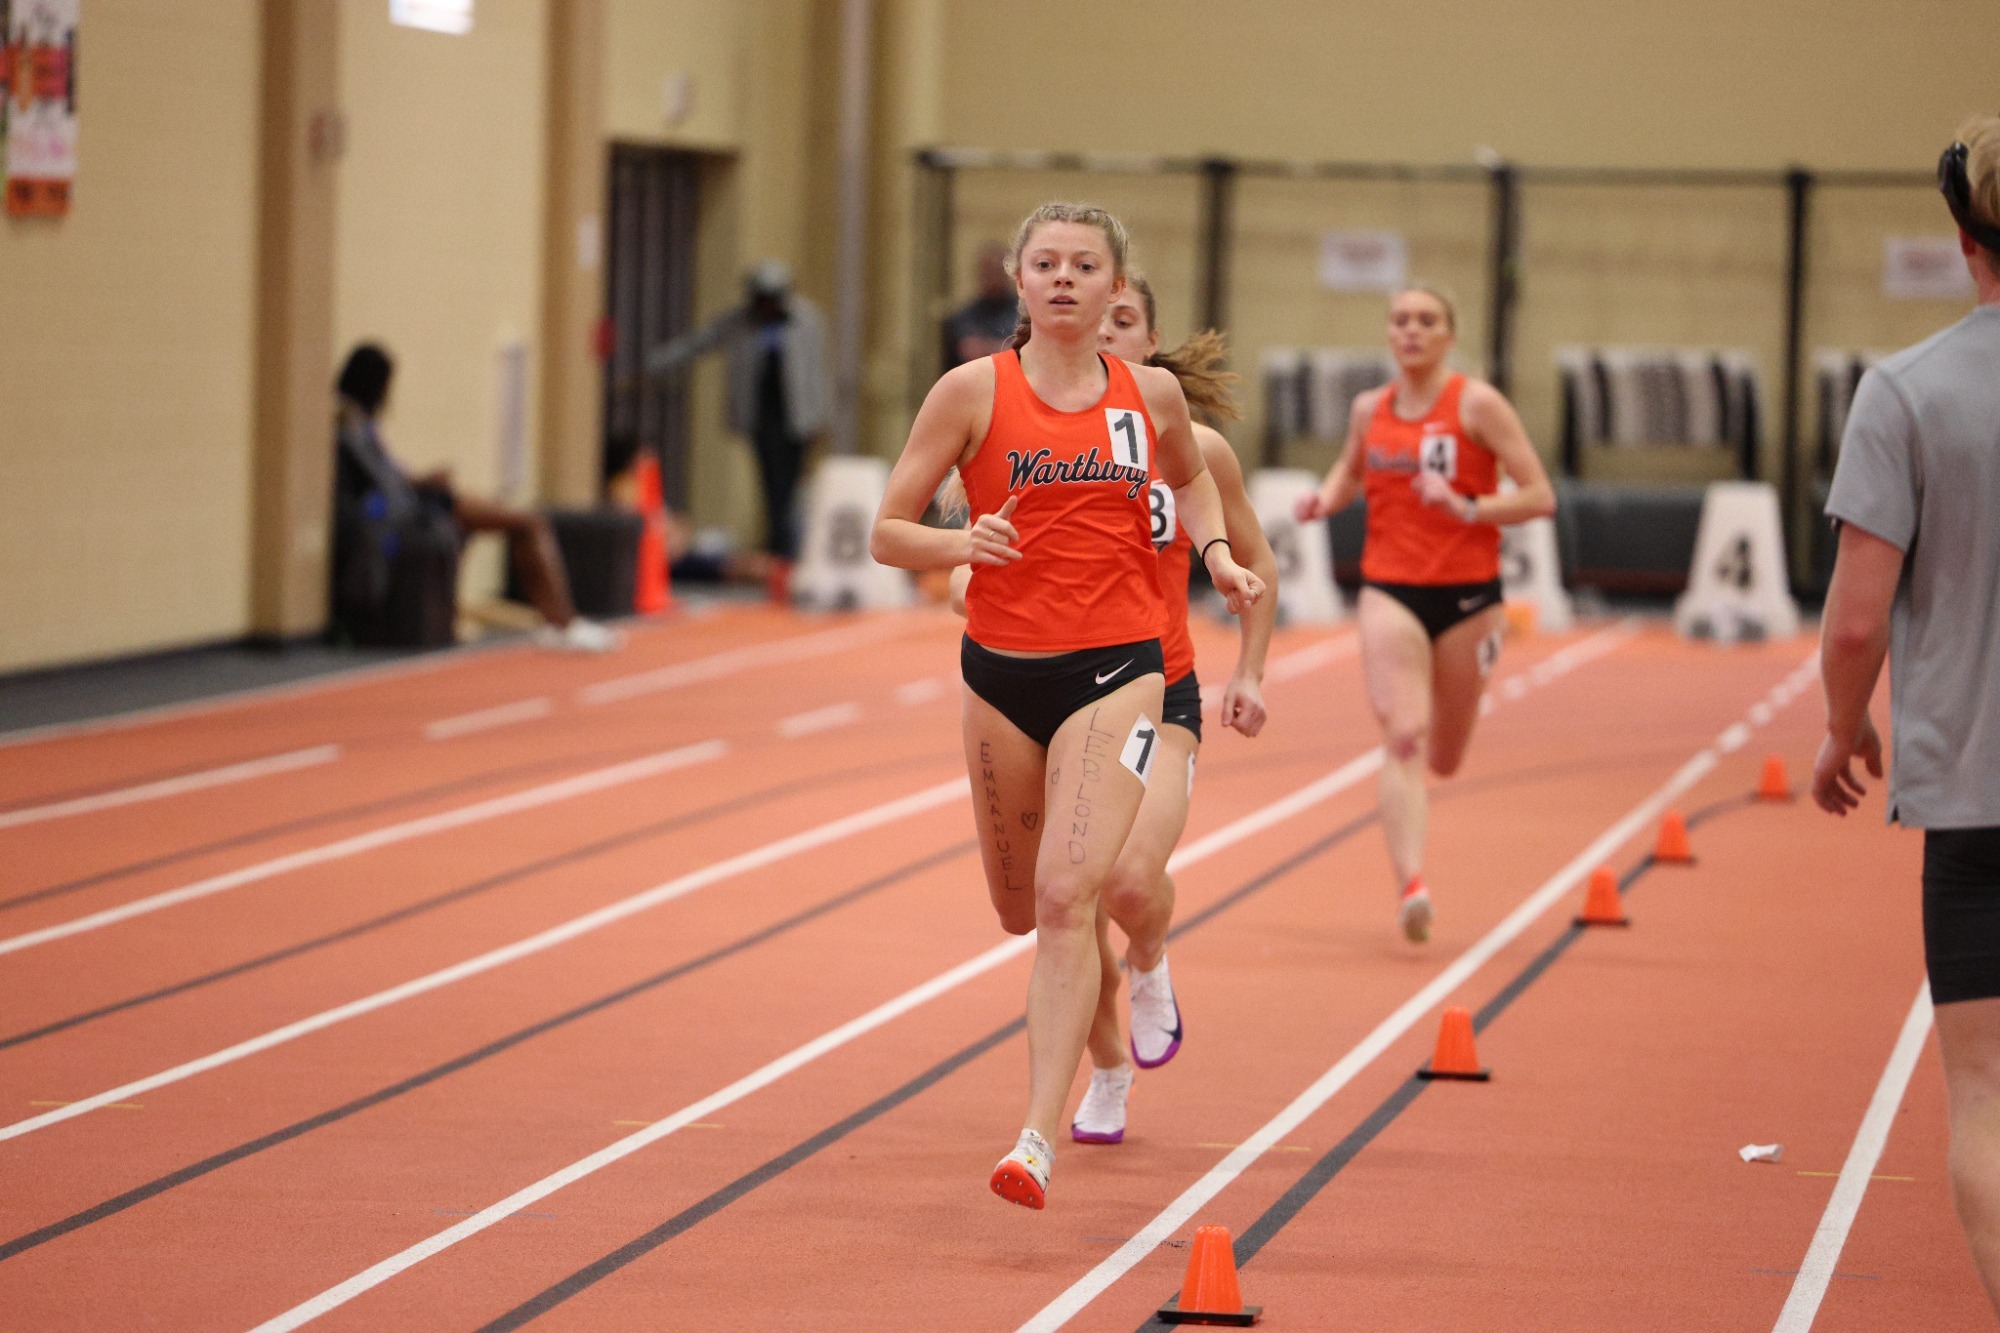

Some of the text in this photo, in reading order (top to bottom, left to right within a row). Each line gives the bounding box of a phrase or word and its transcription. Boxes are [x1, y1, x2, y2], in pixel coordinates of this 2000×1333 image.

[1113, 412, 1139, 464] 1
[1006, 447, 1150, 499] Wartburg
[1715, 532, 1752, 590] 4
[1135, 728, 1156, 776] 1
[980, 741, 1022, 890] EMMANUEL
